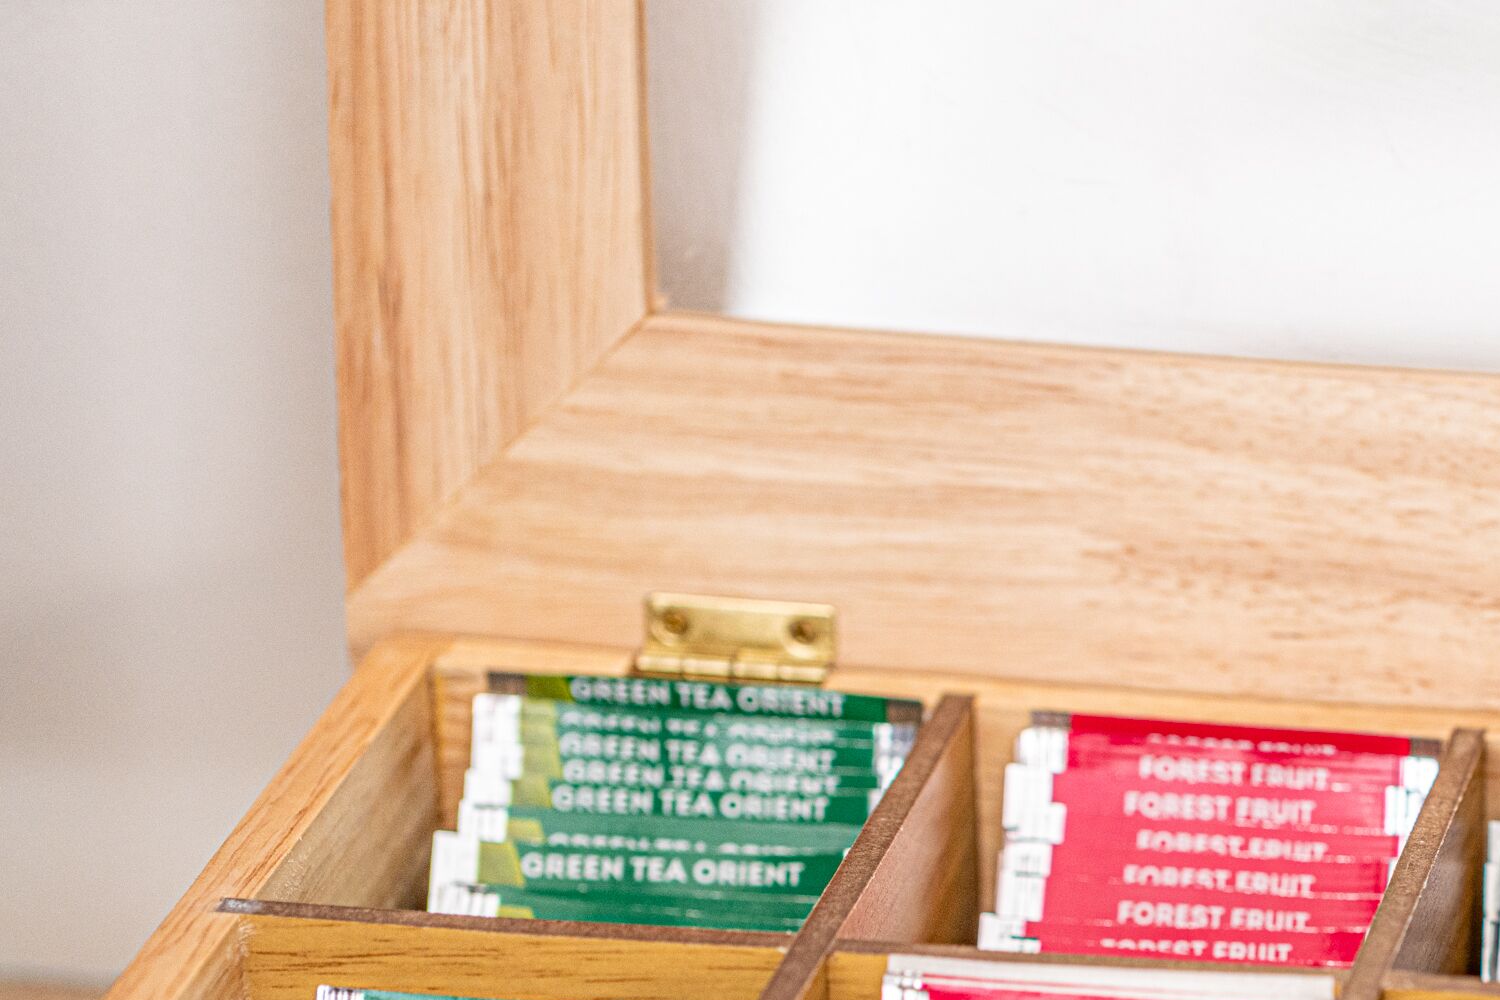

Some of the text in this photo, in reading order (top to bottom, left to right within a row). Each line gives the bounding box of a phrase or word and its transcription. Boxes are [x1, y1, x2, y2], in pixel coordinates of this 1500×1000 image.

[569, 678, 845, 716] GREEN TEA ORIENT
[665, 739, 721, 766] TEA
[1138, 754, 1331, 790] FOREST FRUIT
[552, 785, 830, 822] GREEN TEA ORIENT
[1123, 790, 1317, 826] FOREST FRUIT
[520, 852, 805, 887] GREEN TEA ORIENT
[1117, 900, 1311, 931] FOREST FRUIT
